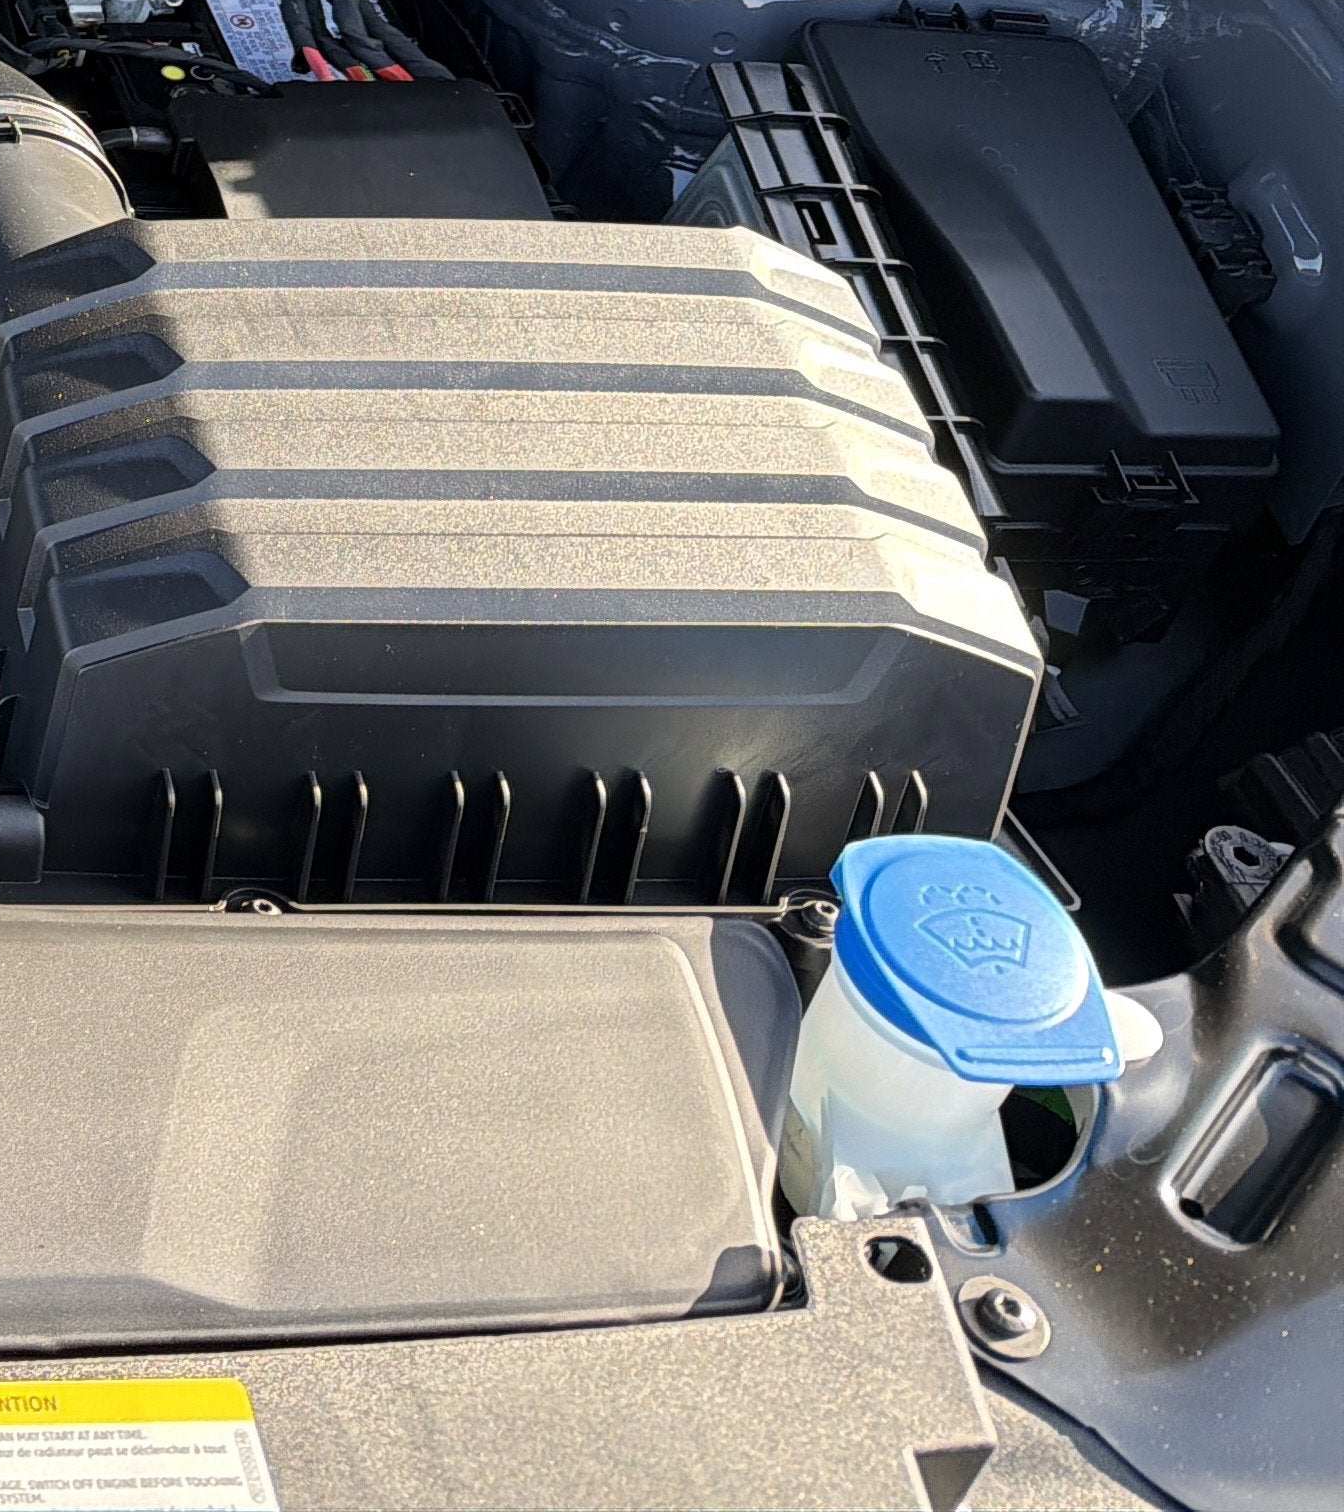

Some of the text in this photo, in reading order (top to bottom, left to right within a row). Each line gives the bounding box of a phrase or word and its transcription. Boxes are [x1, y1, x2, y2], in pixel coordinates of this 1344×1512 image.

[17, 1431, 39, 1442] MAY
[42, 1431, 75, 1442] START
[78, 1430, 90, 1441] AT
[17, 1447, 31, 1458] de
[34, 1446, 84, 1458] radiateur
[88, 1447, 113, 1459] peut
[116, 1448, 128, 1457] se
[203, 1445, 226, 1454] tout
[28, 1479, 70, 1491] SWITCH
[73, 1479, 93, 1490] OFF
[96, 1478, 138, 1489] ENGINE
[140, 1477, 183, 1488] BEFORE
[185, 1476, 243, 1487] TOUCHING
